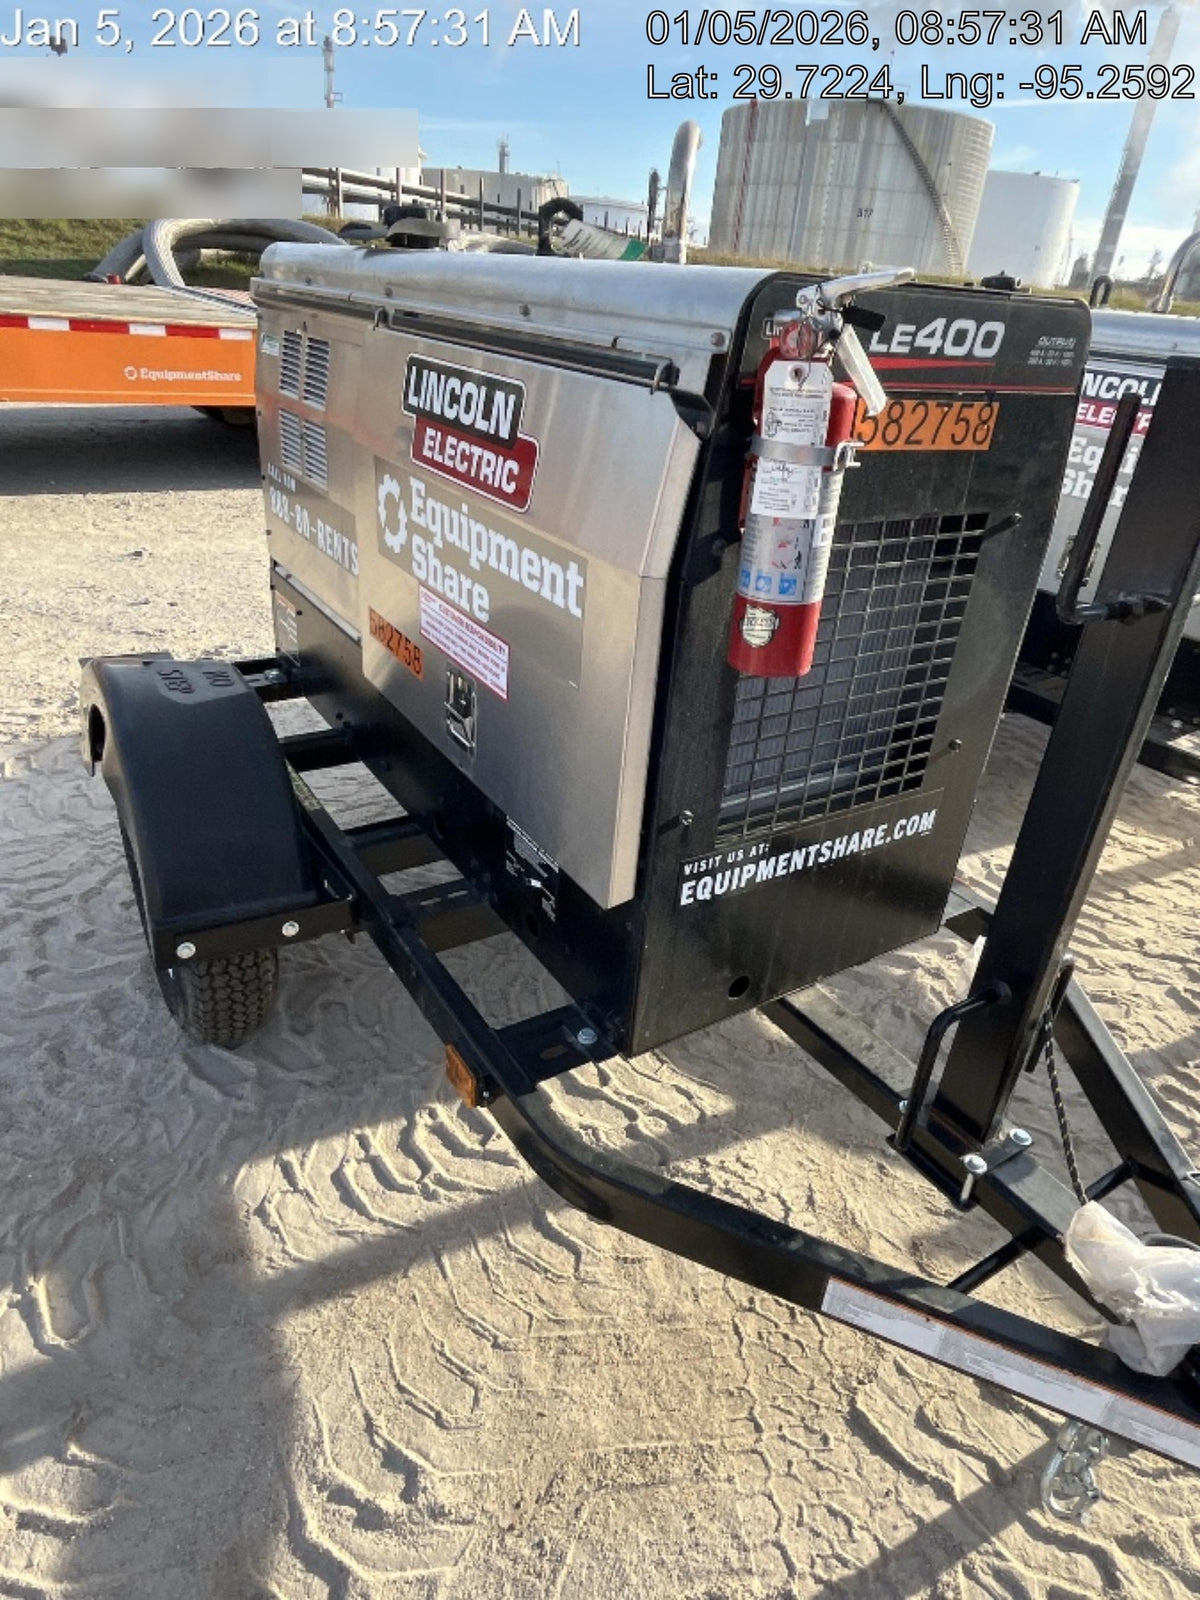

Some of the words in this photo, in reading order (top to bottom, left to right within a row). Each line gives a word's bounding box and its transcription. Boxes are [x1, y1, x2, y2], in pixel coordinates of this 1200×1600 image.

[139, 367, 242, 382] EquipmentShare
[408, 365, 516, 440] LINCOLN
[857, 400, 994, 446] 582758
[422, 426, 520, 494] ELECTRIC
[409, 475, 585, 619] Equipment
[411, 533, 490, 624] Share
[680, 809, 937, 906] EQUIPMENTSHARE.COM
[683, 854, 722, 876] VISIT
[726, 848, 744, 864] US
[749, 843, 770, 858] AT:
